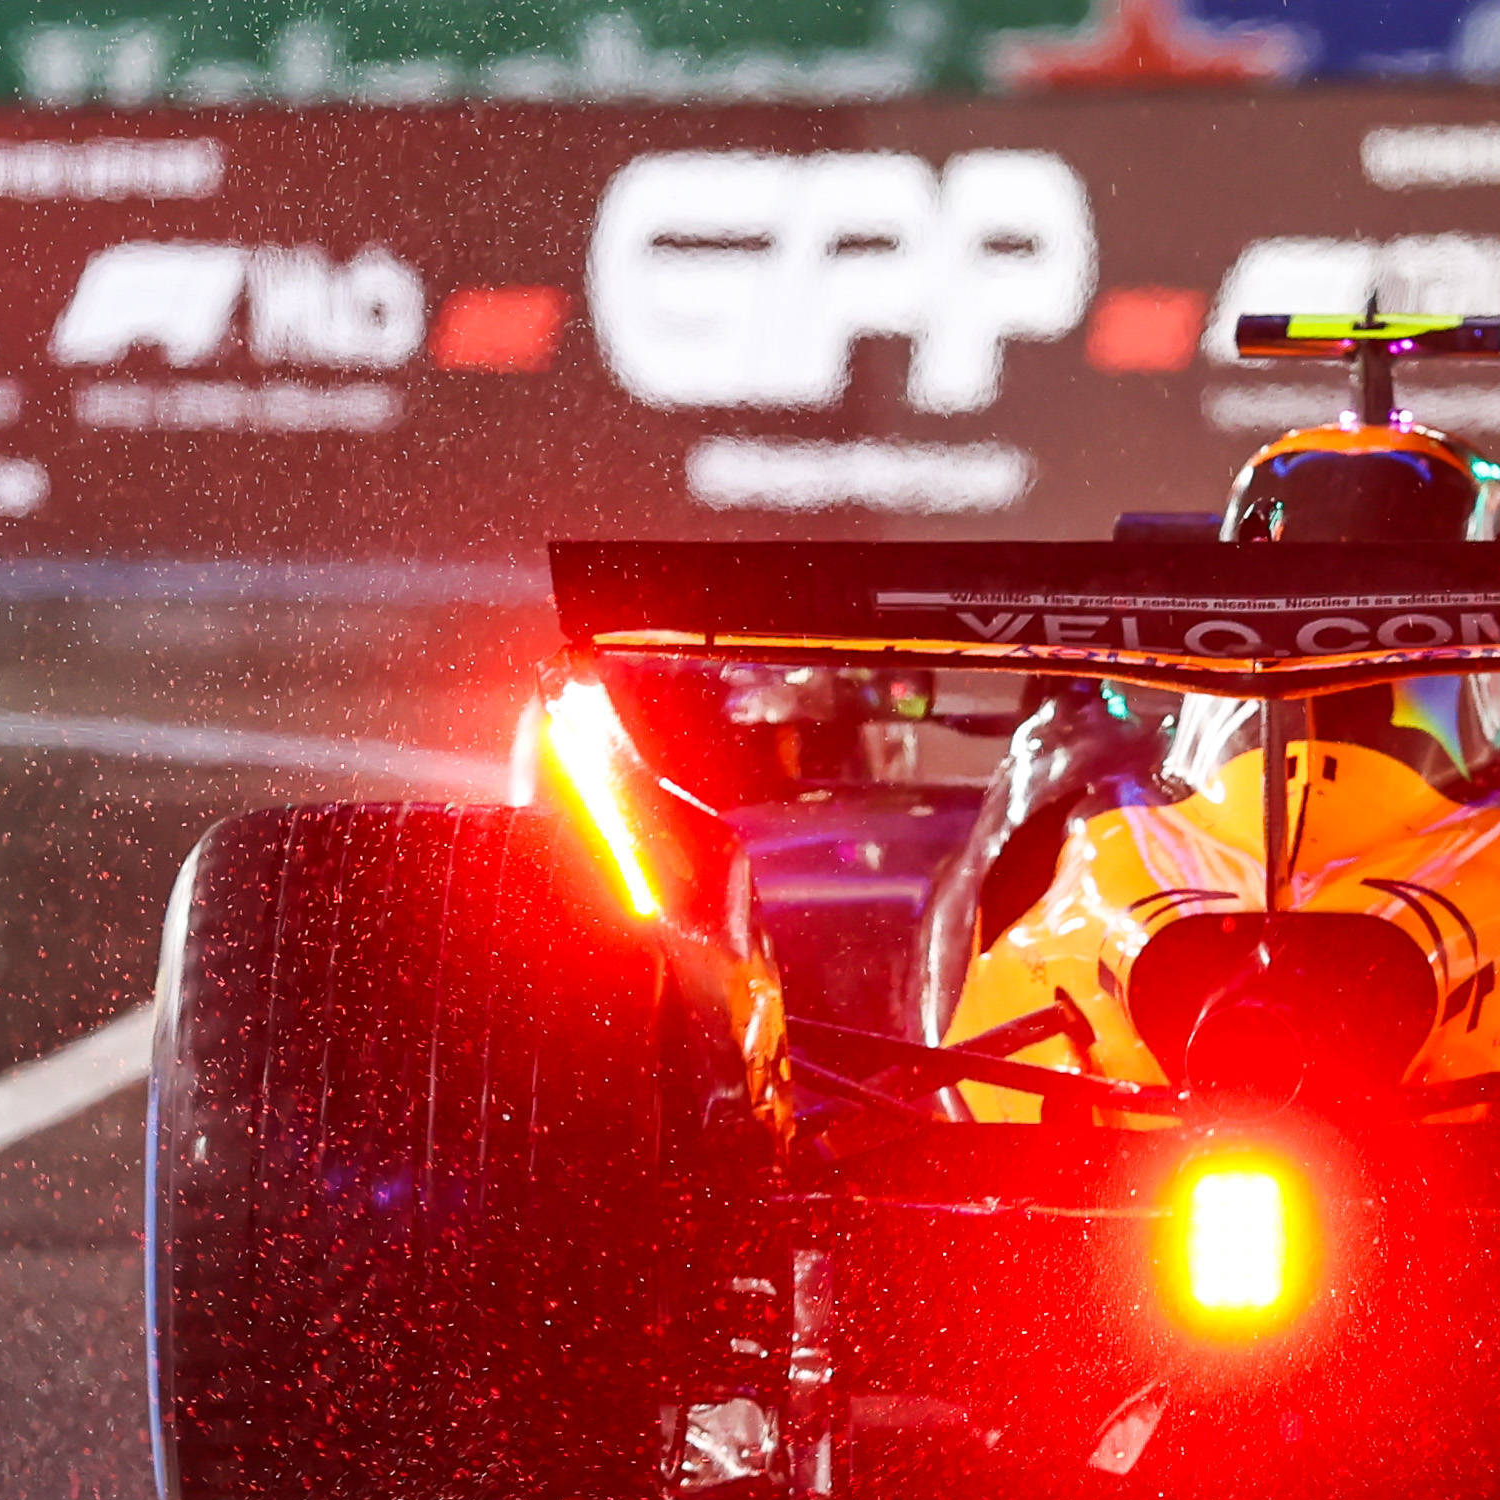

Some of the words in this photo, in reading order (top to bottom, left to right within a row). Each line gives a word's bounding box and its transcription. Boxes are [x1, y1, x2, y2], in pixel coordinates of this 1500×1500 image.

[1079, 595, 1138, 609] product
[1143, 598, 1210, 610] contains
[1284, 596, 1350, 610] Nicotine
[1356, 595, 1369, 606] is
[1397, 592, 1469, 605] addictive
